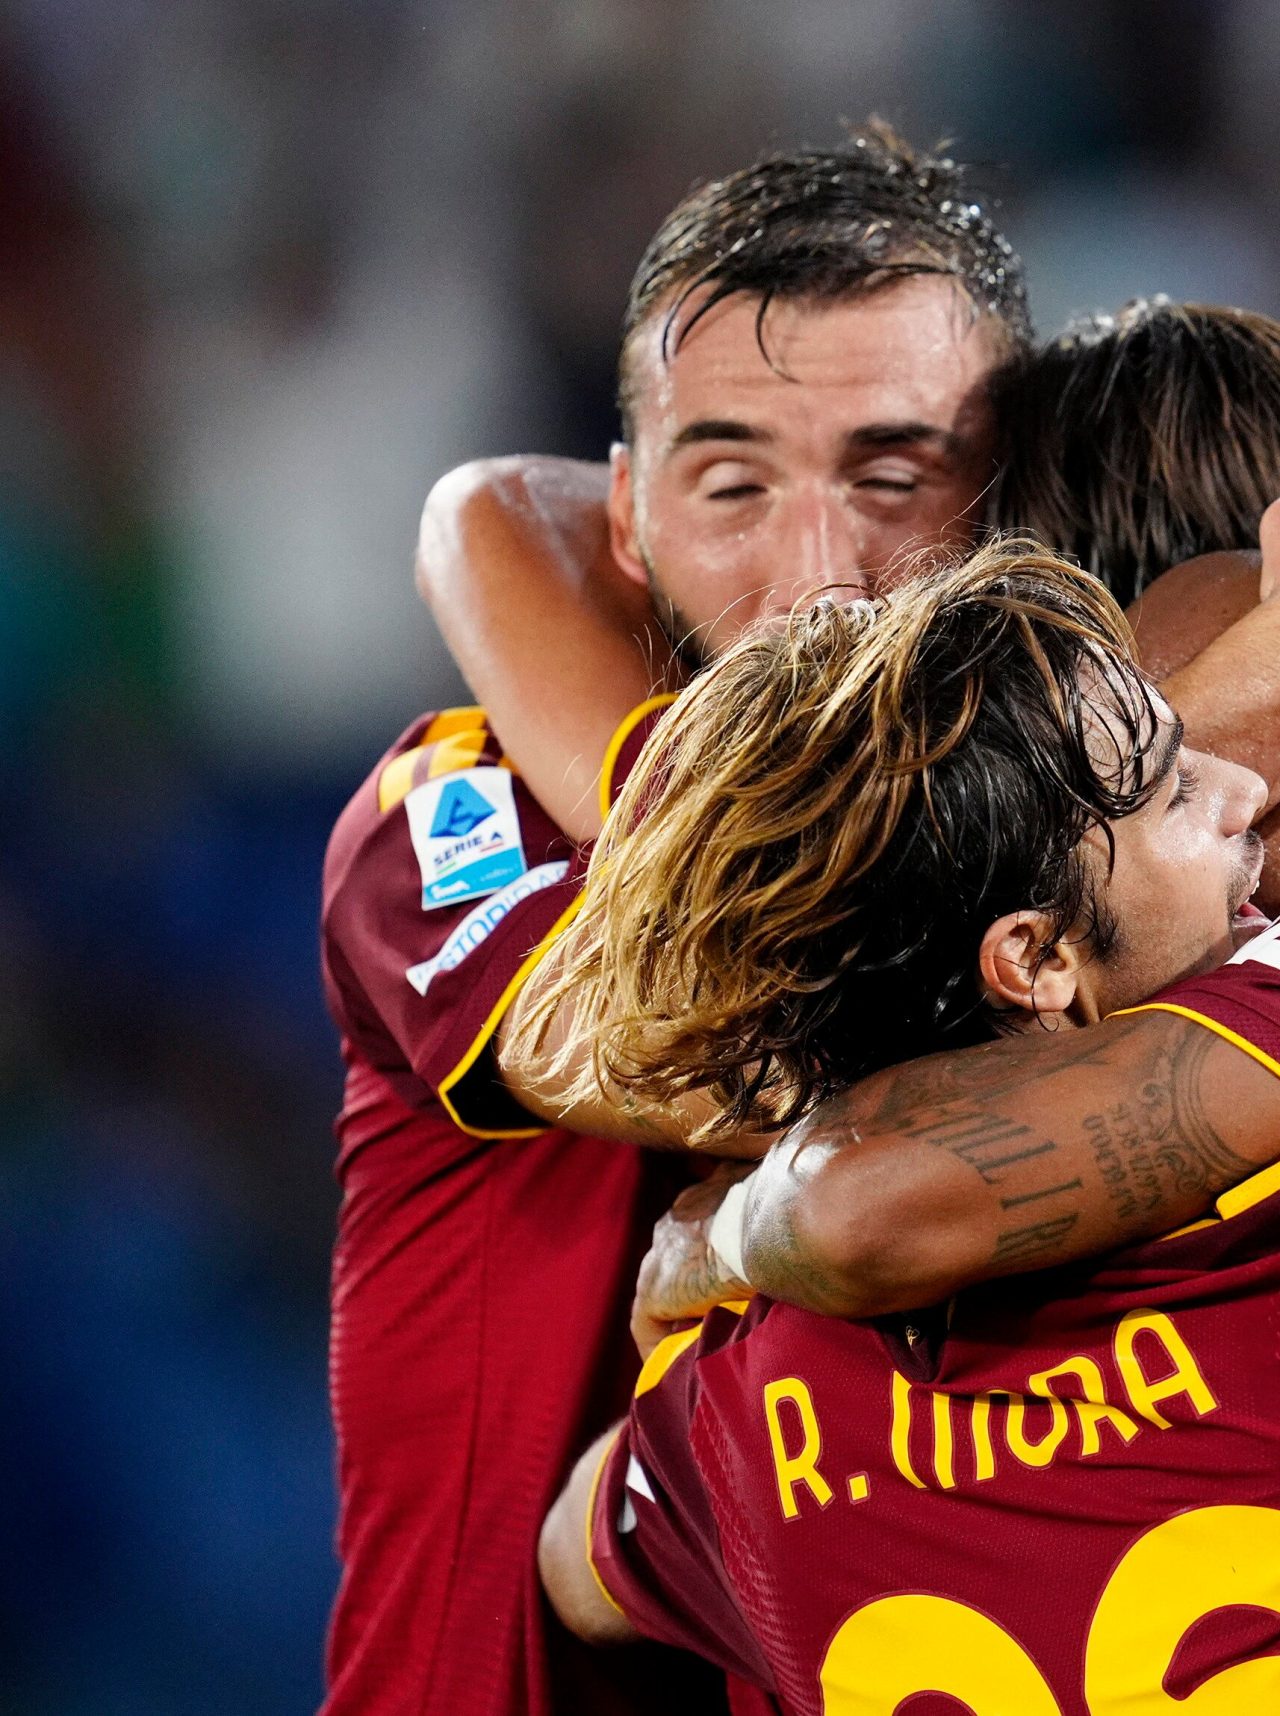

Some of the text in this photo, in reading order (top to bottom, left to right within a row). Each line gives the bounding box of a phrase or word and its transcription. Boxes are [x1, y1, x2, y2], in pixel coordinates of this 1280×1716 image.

[434, 831, 503, 865] SERIE A
[764, 1308, 1220, 1519] R. MORA
